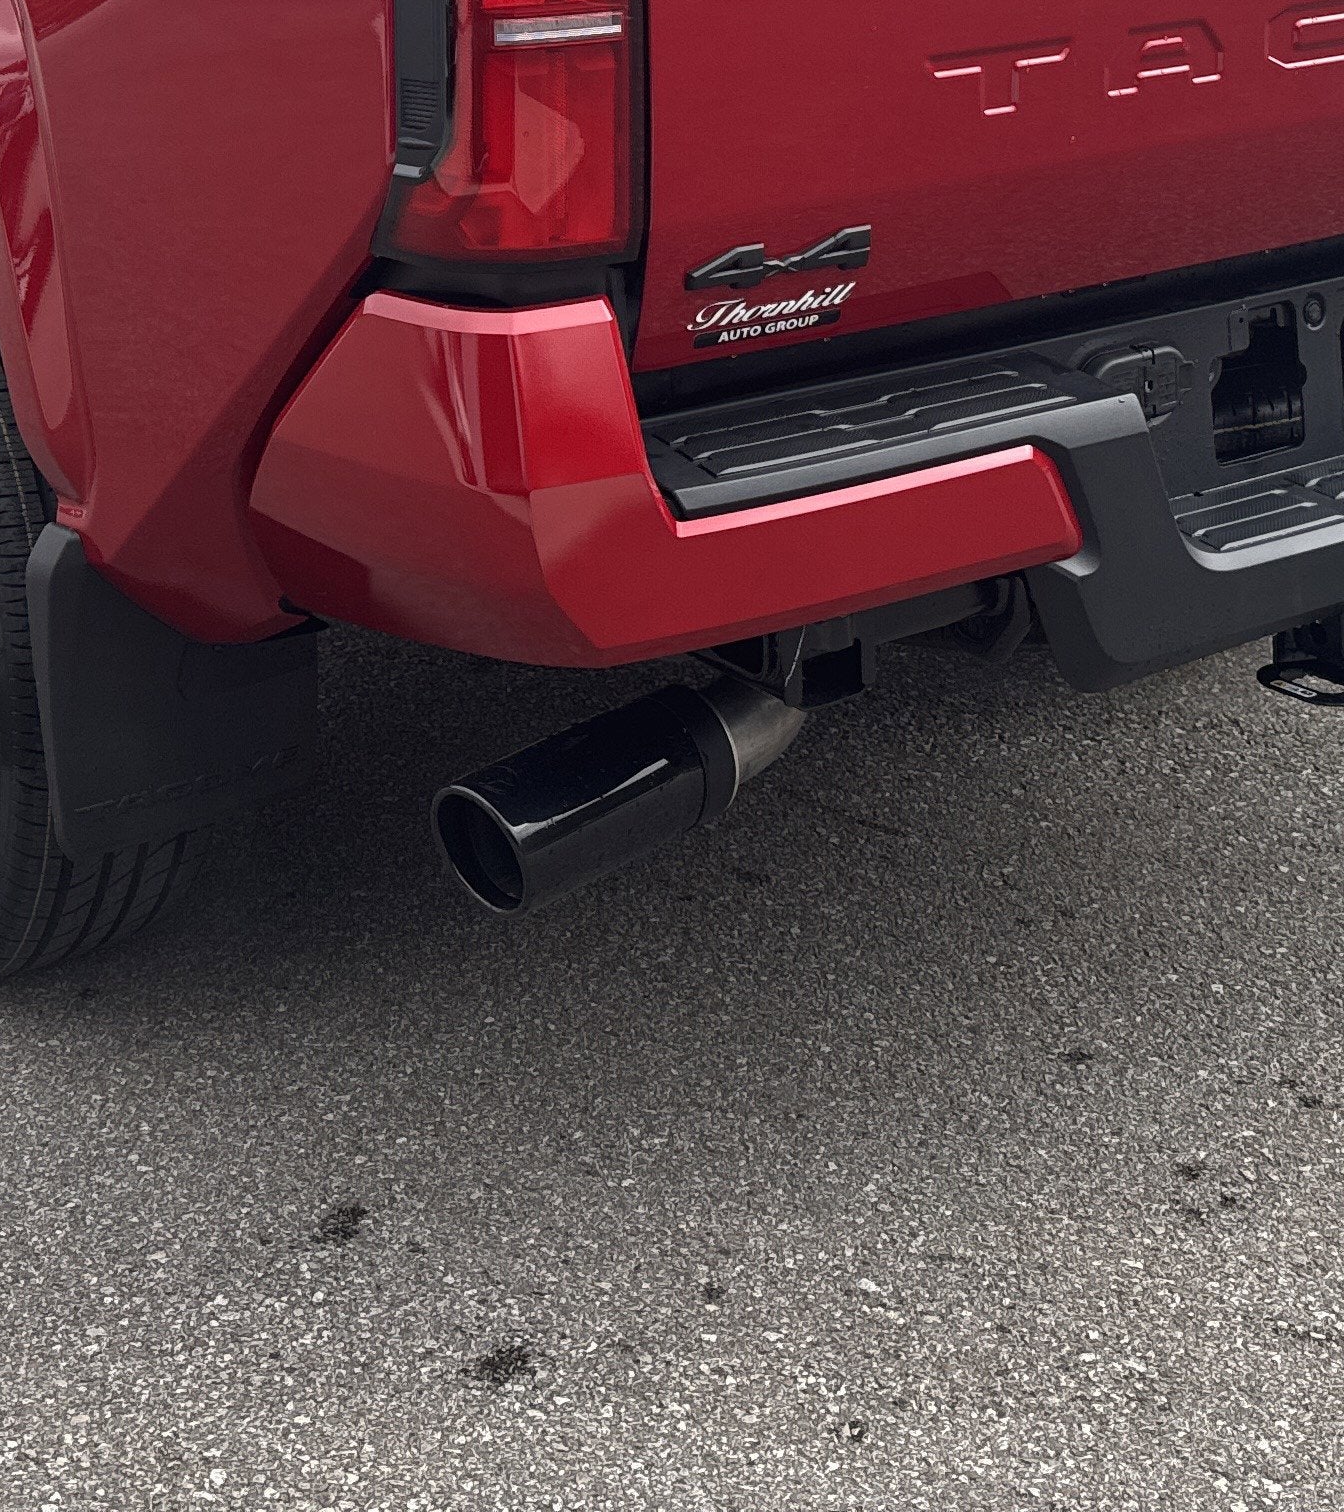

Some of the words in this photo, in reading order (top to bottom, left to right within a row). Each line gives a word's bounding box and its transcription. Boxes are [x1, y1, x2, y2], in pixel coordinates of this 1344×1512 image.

[686, 280, 857, 332] Thornhill
[717, 325, 762, 344] AUTO
[765, 313, 820, 335] GROUP
